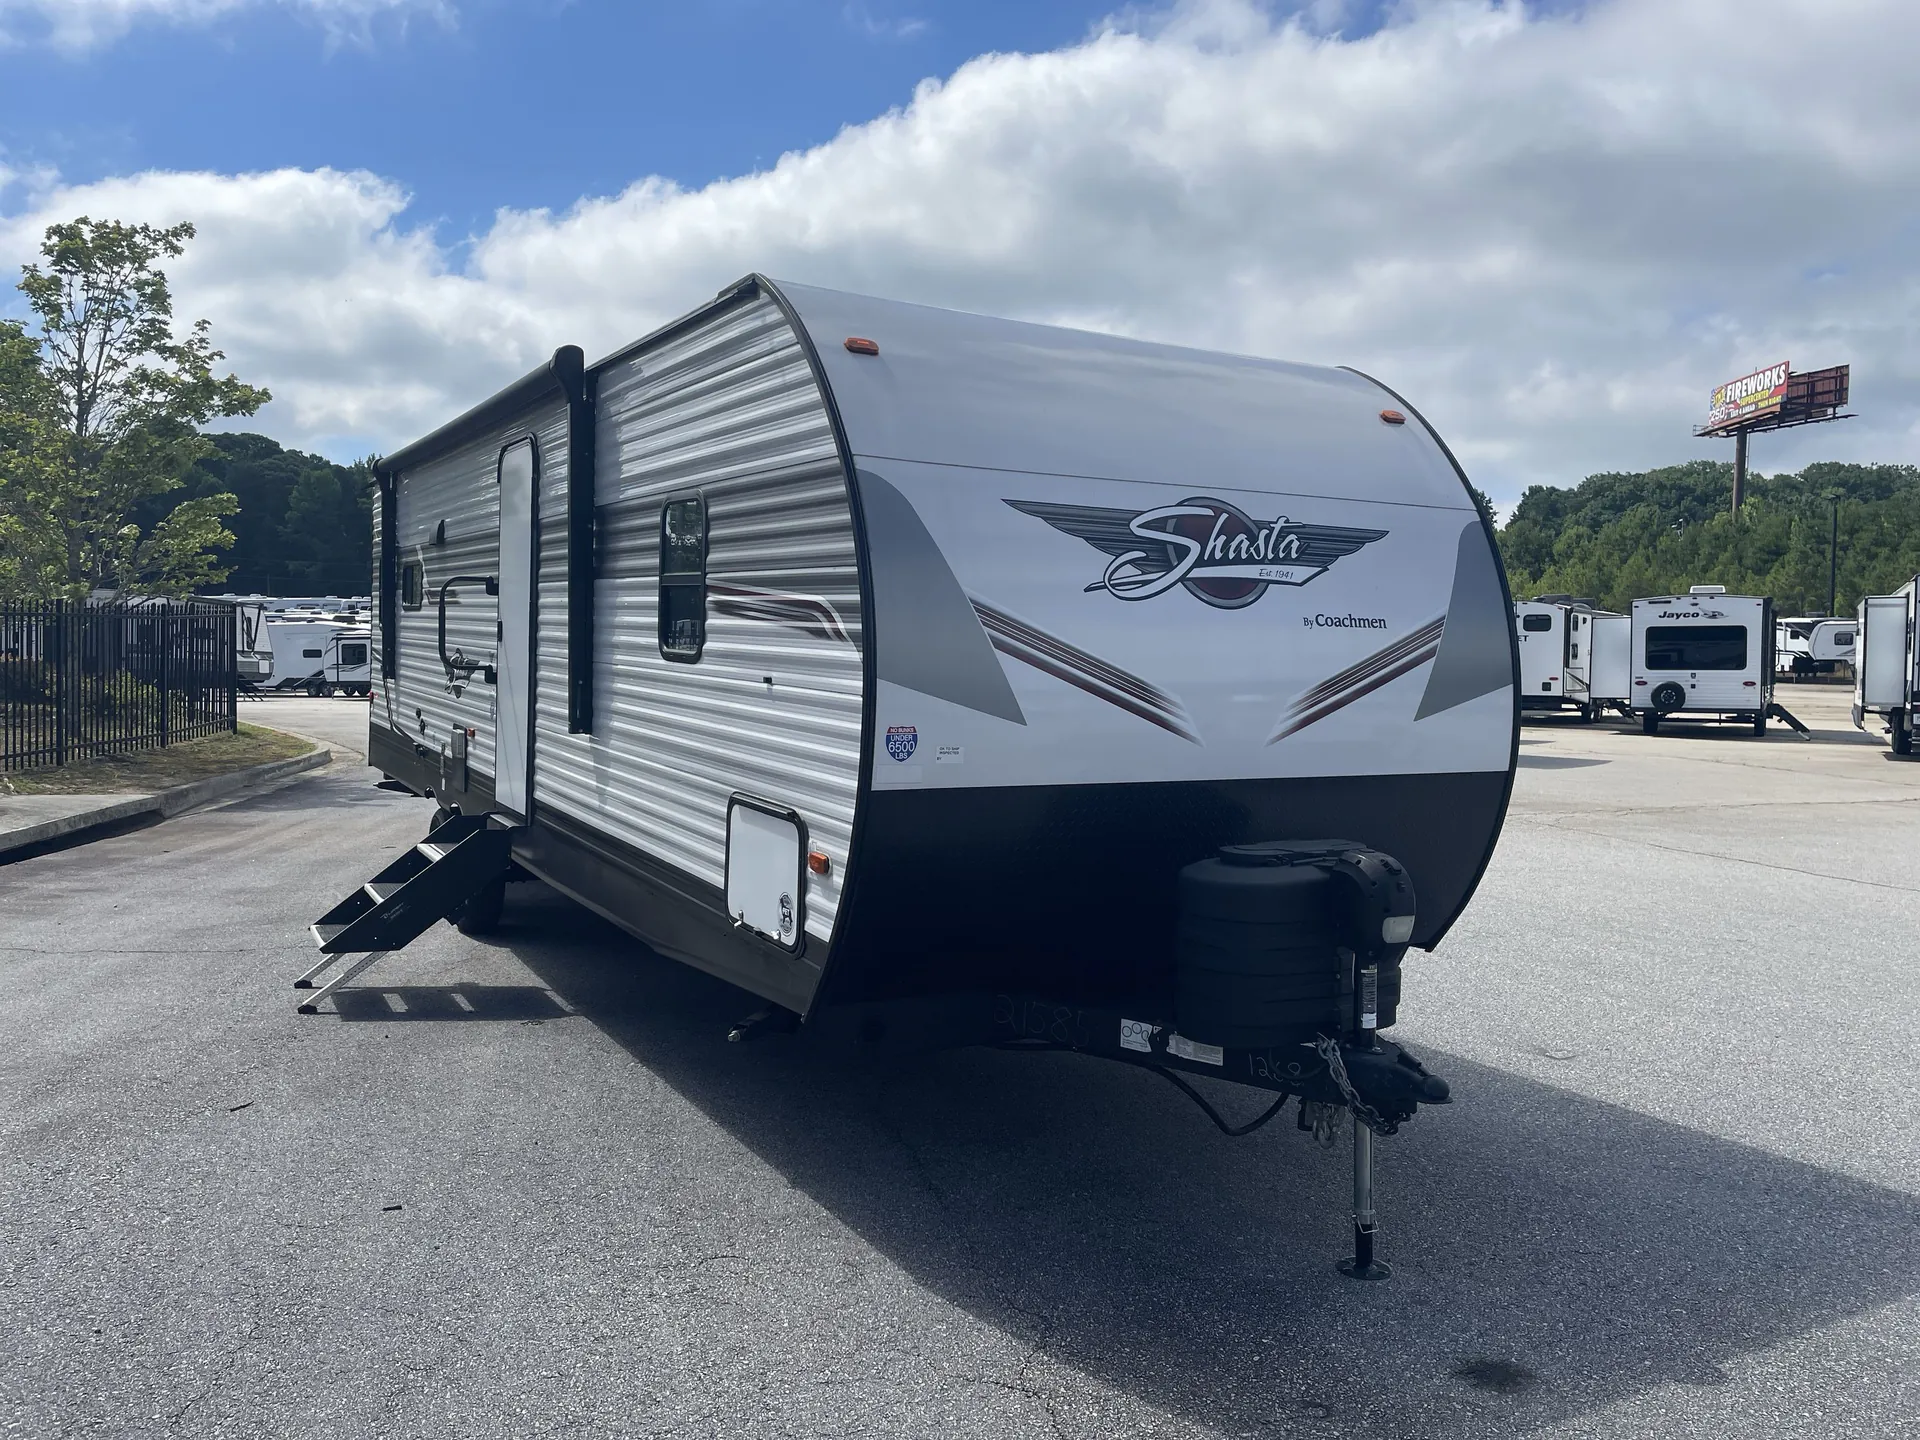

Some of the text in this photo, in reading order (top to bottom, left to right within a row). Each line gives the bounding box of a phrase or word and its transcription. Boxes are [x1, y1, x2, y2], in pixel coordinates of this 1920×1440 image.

[1726, 364, 1786, 403] FIREWORKS
[1103, 504, 1303, 601] Shasta
[1259, 568, 1294, 579] Est. 1941
[1658, 611, 1700, 620] Jayco
[1303, 614, 1387, 629] By Coachmen
[890, 734, 913, 742] UNDER
[888, 741, 915, 753] 6500
[895, 752, 908, 760] LBS
